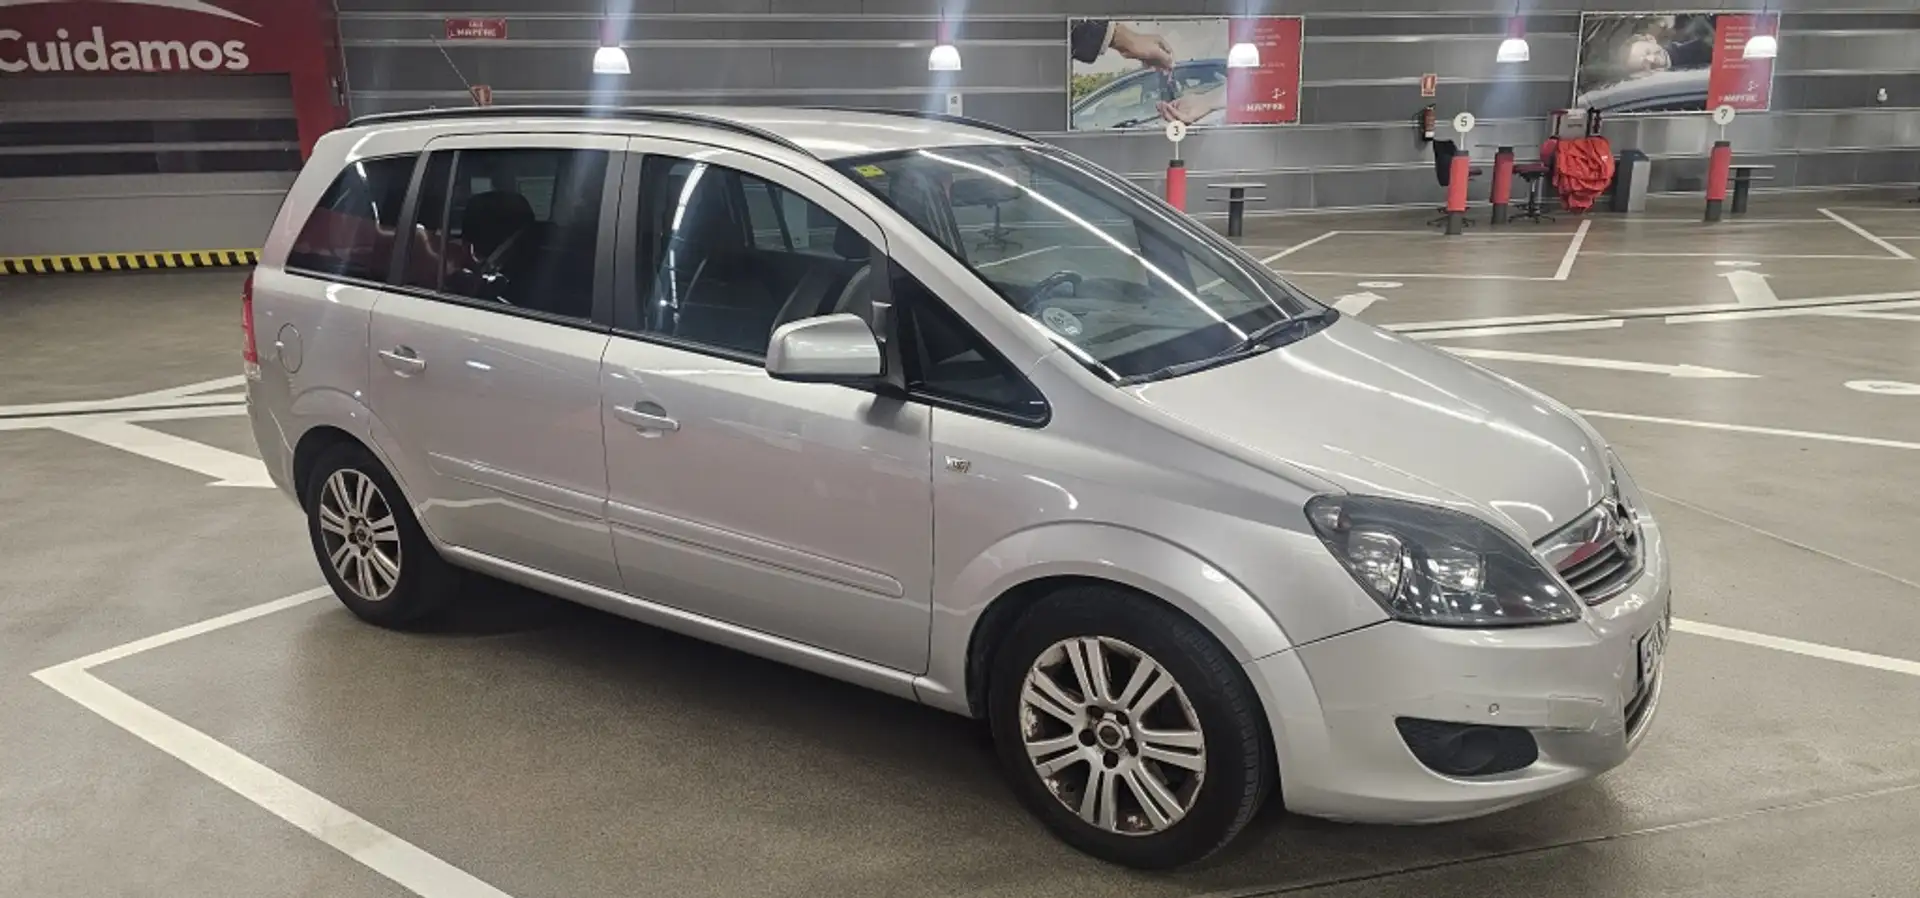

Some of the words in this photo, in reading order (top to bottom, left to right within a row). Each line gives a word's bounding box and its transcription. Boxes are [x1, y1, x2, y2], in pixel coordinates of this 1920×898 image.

[0, 26, 250, 73] Cuidamos
[1720, 108, 1728, 120] 7
[1460, 115, 1468, 127] 5
[1173, 125, 1180, 136] 3
